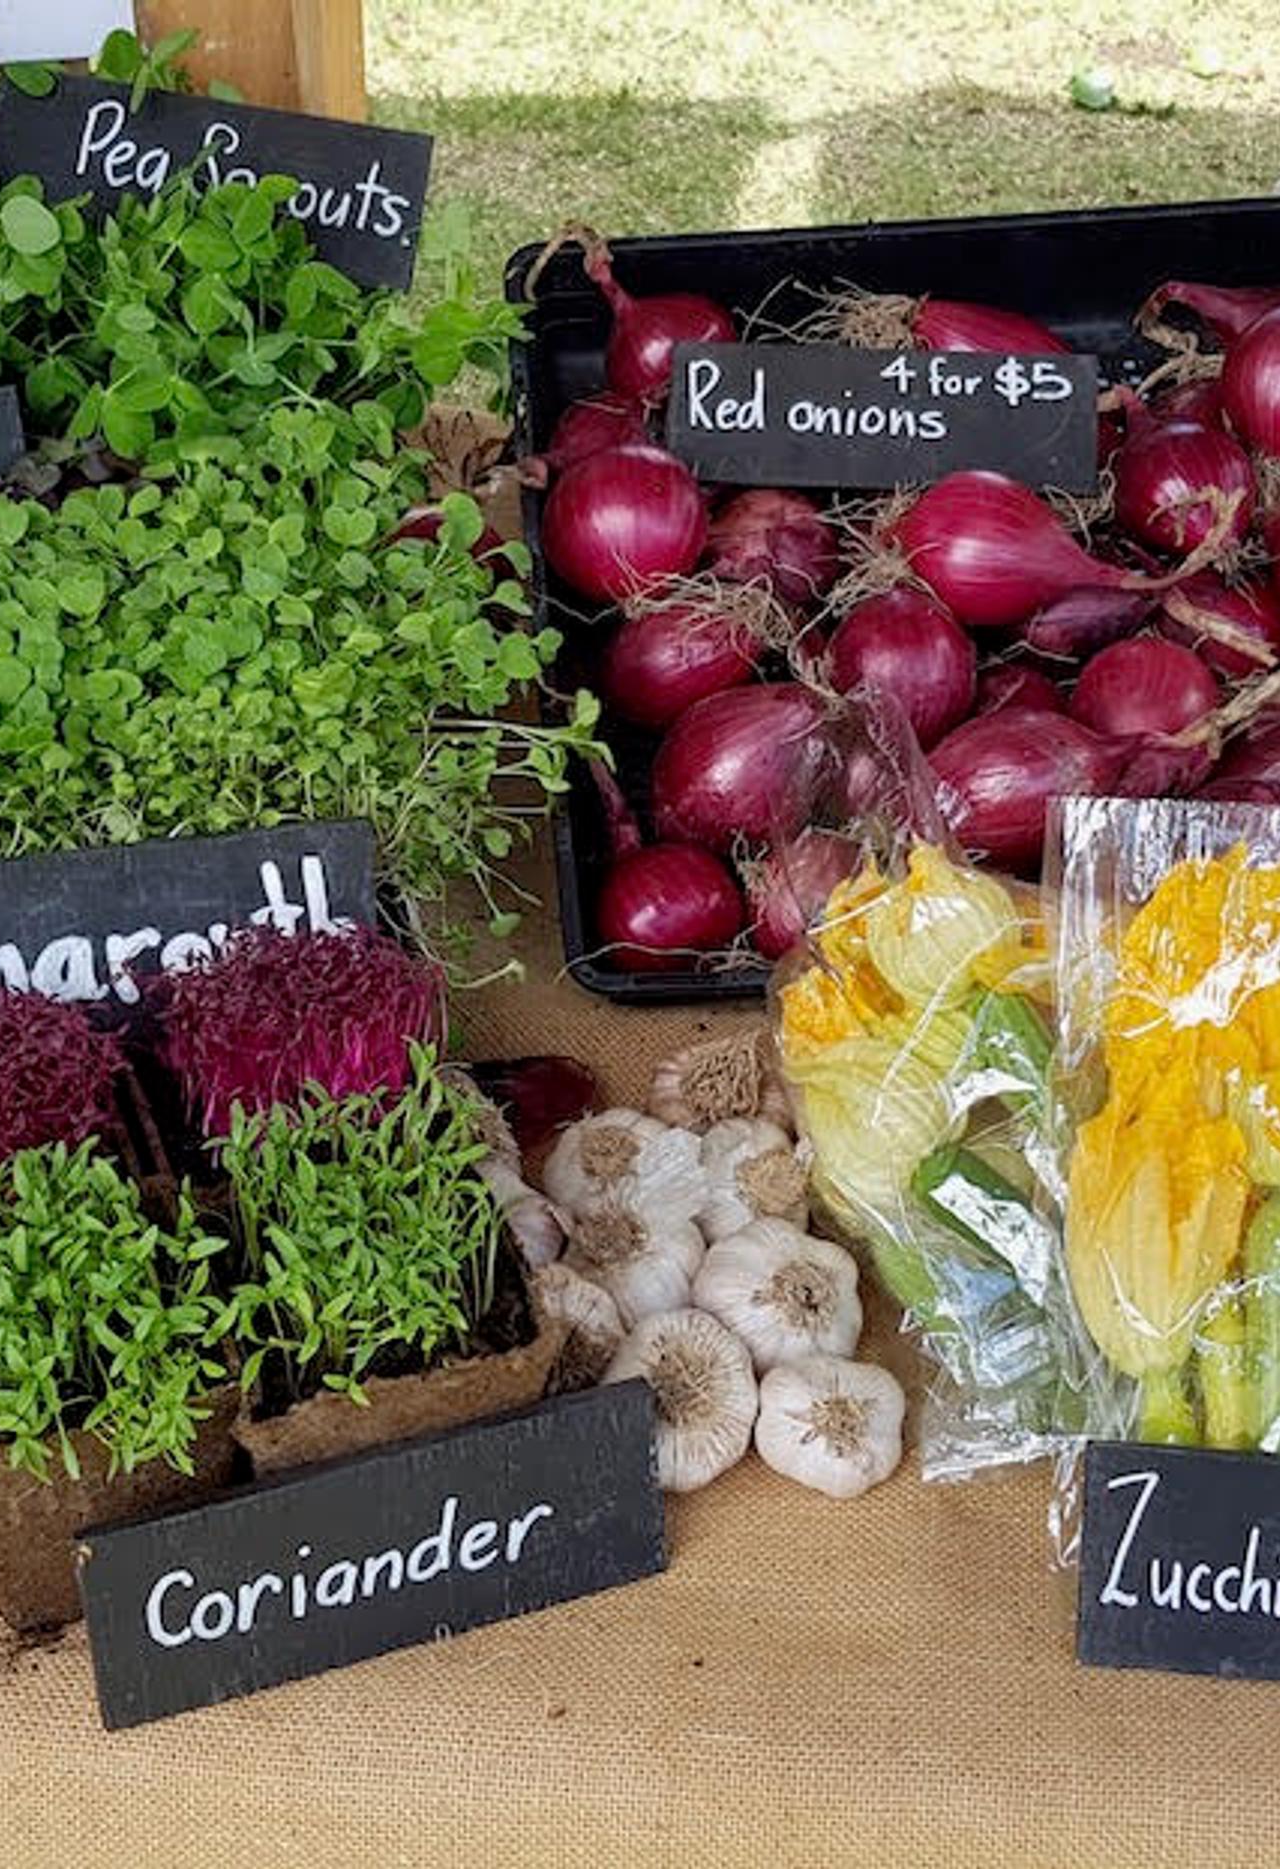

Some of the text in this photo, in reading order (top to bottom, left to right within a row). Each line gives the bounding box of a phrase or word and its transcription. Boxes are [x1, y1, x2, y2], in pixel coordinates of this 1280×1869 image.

[76, 100, 411, 247] Pea Souts.
[688, 359, 947, 439] Red onions
[880, 354, 1073, 406] 4 for $5
[145, 1496, 554, 1648] Coriander
